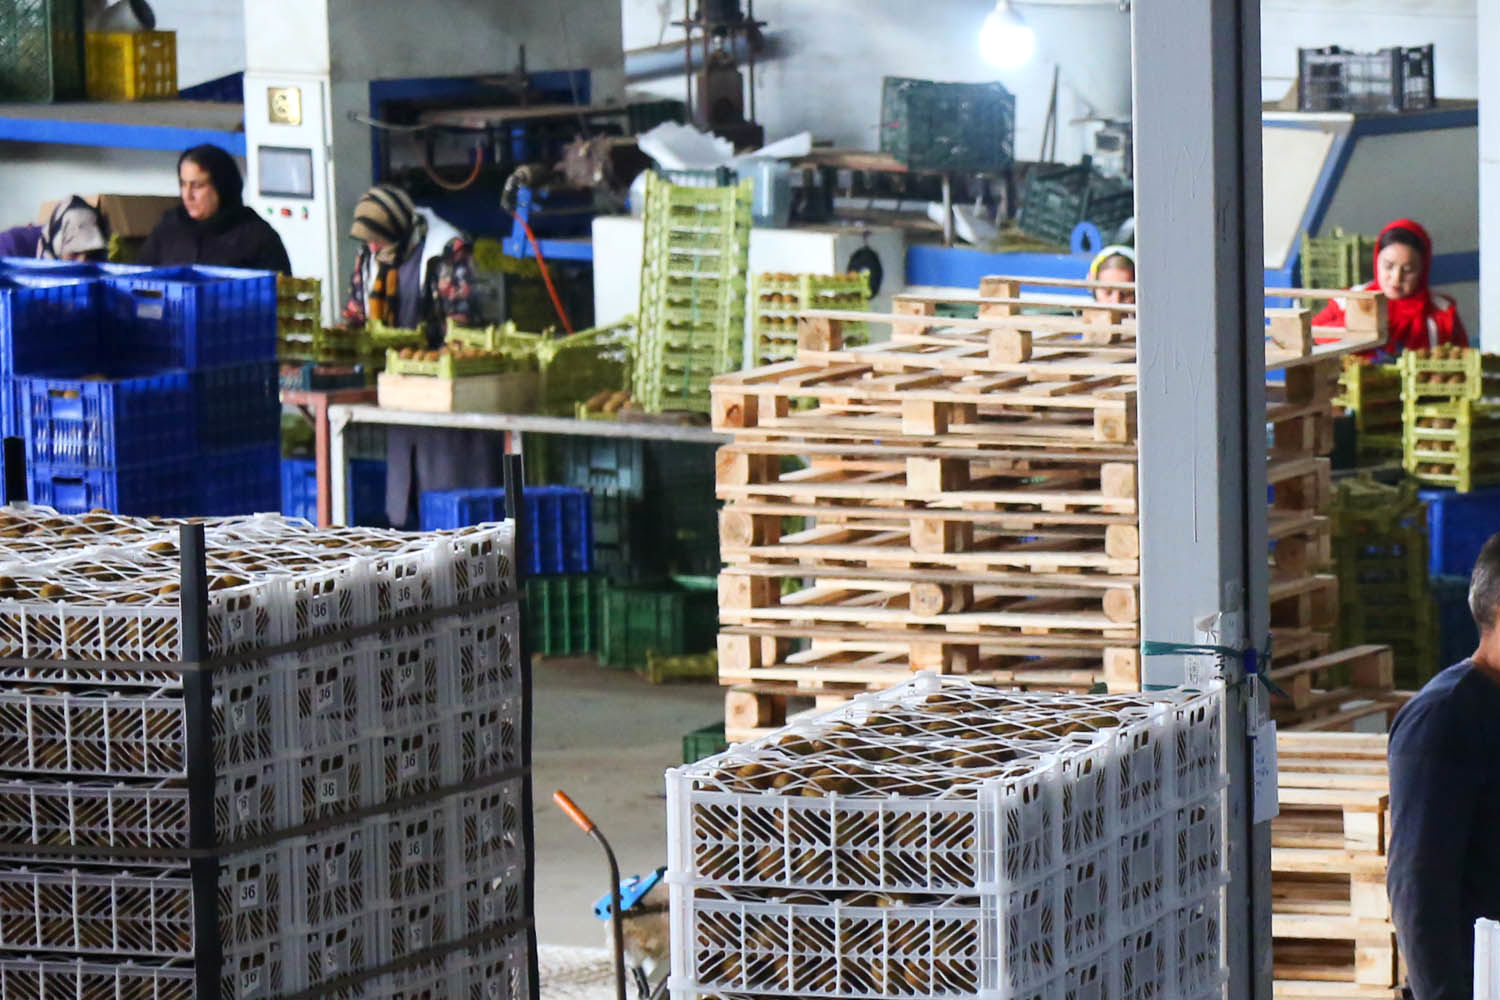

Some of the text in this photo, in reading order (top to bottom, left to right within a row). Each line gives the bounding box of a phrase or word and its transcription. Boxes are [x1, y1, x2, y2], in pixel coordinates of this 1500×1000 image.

[472, 561, 483, 578] 36
[398, 586, 411, 602] 36
[314, 602, 327, 618] 36
[319, 687, 331, 703] 36
[404, 753, 416, 769] 36
[322, 782, 335, 796] 36
[408, 840, 420, 857] 36
[241, 884, 256, 900] 36
